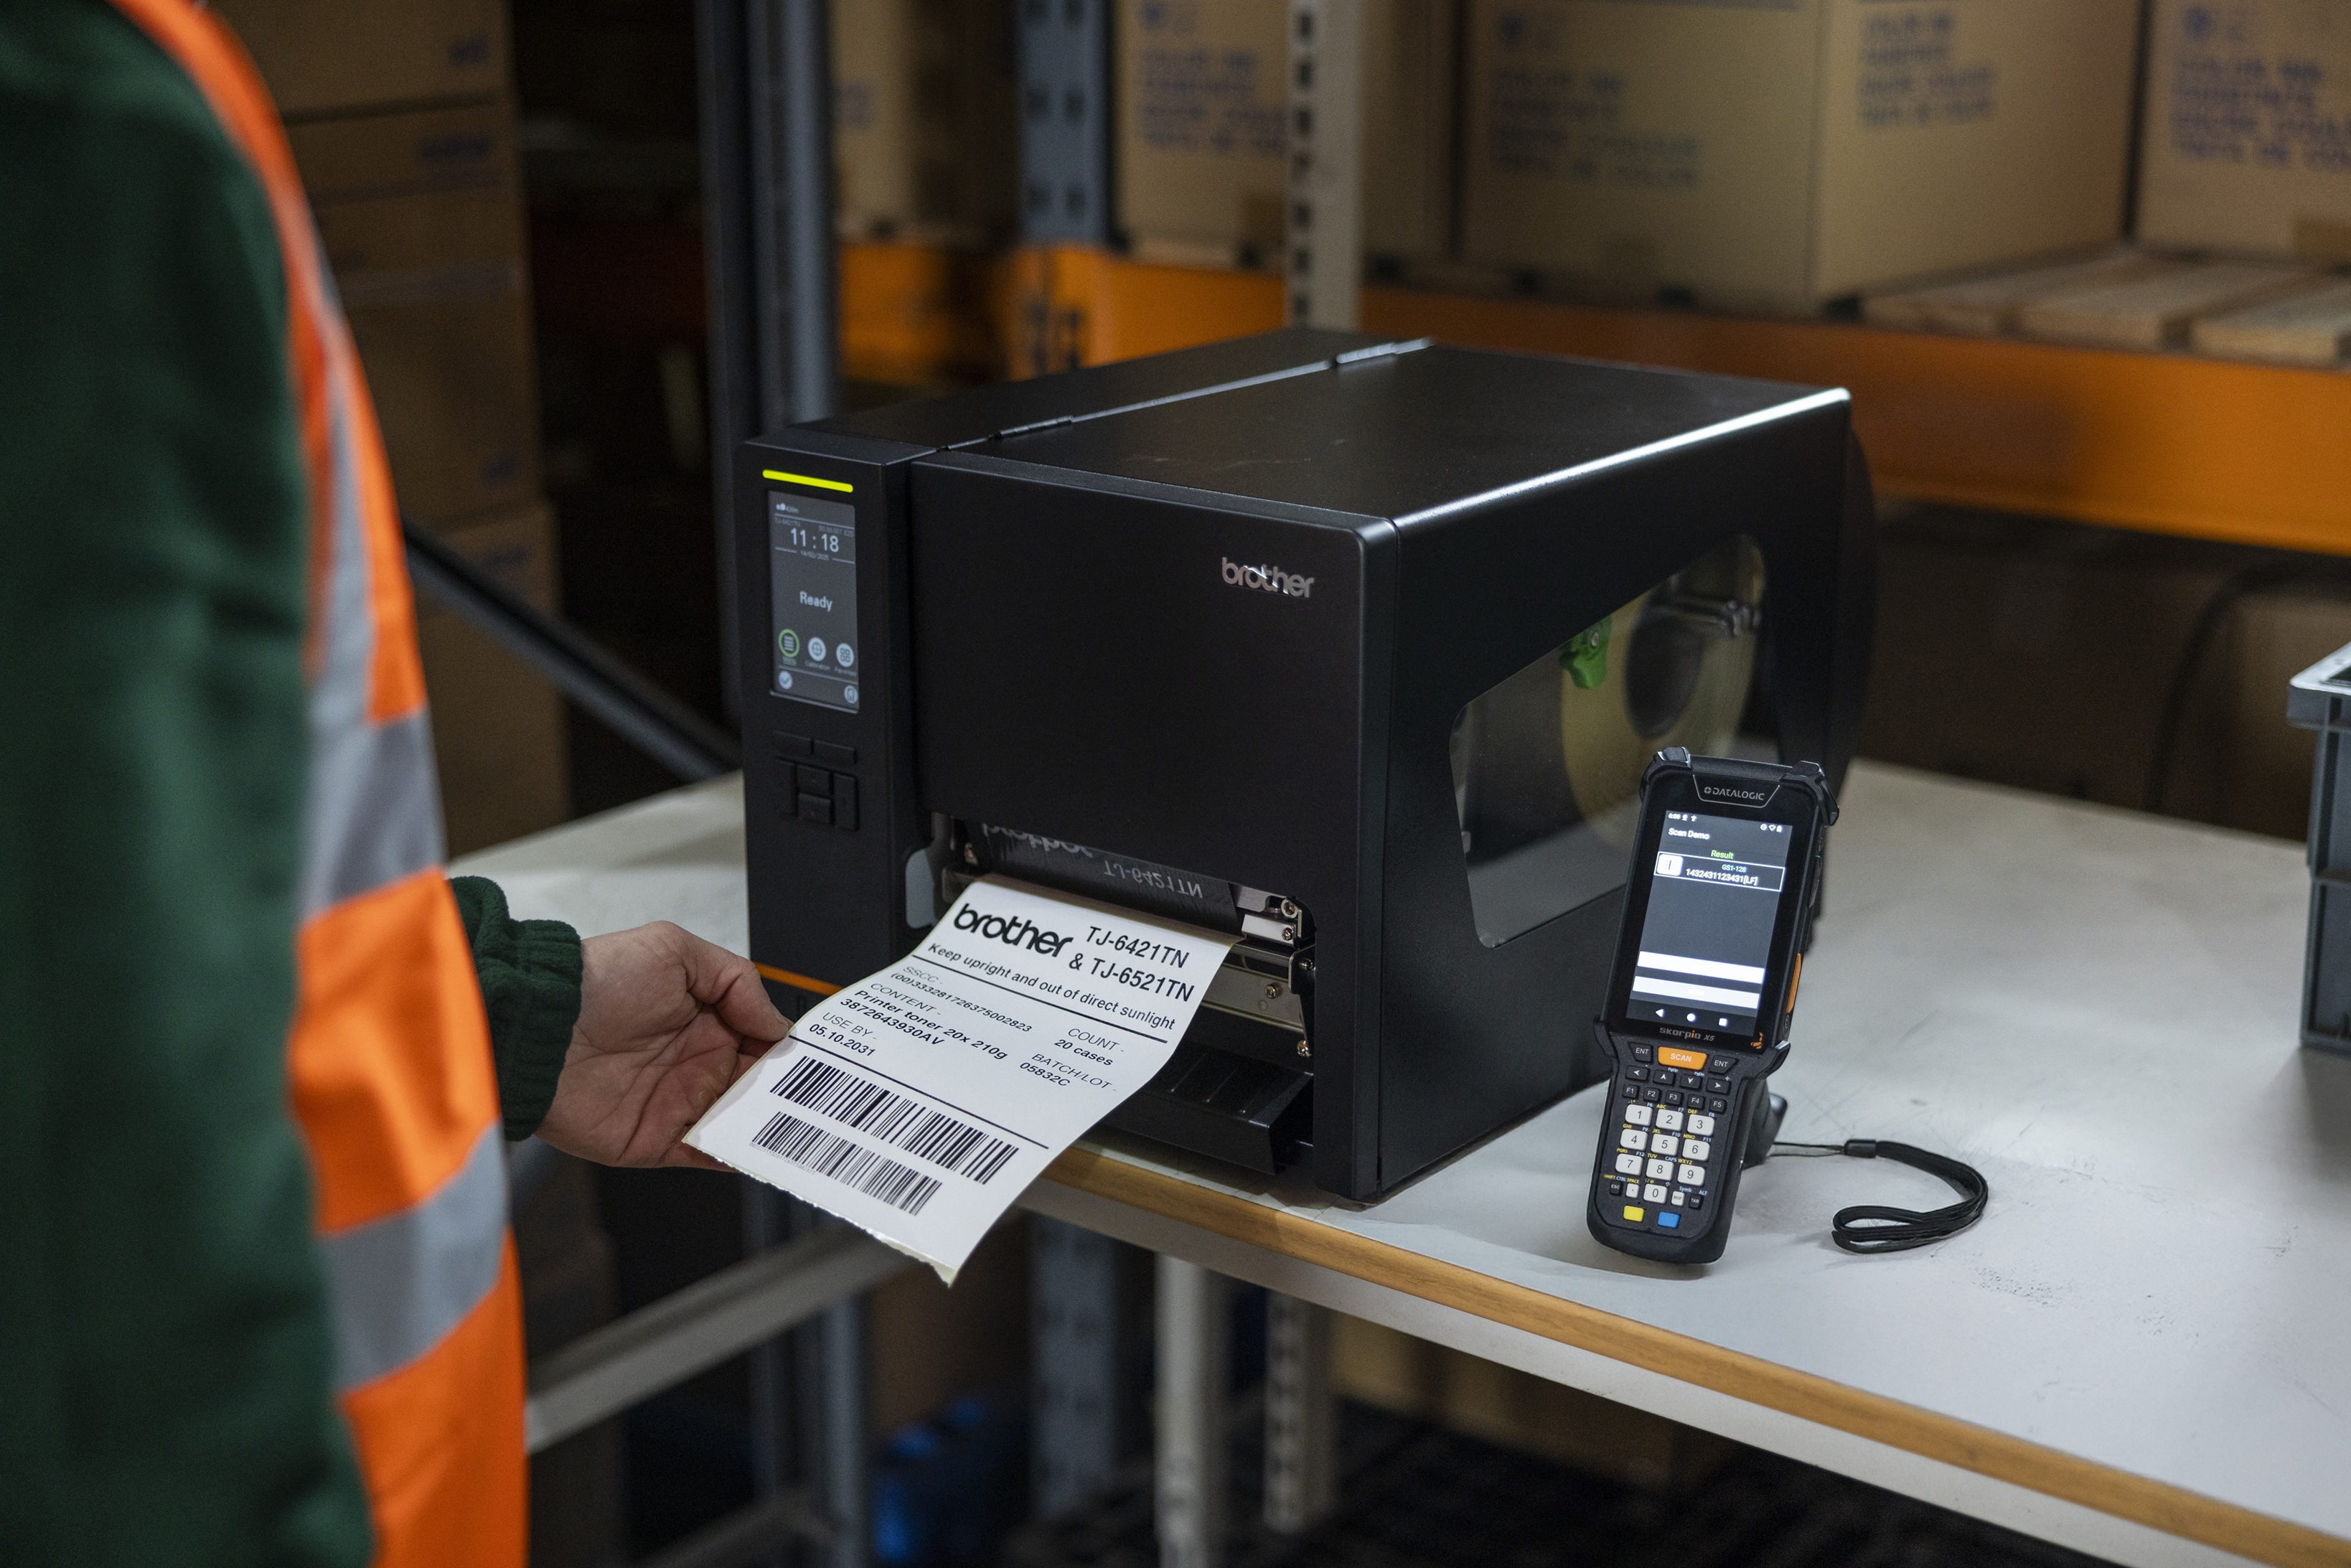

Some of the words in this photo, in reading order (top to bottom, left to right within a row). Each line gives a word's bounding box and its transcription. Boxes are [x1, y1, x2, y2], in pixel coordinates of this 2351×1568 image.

[1221, 557, 1315, 598] brother
[799, 591, 833, 611] Ready
[1712, 787, 1765, 801] DATALOGIC
[1668, 827, 1687, 837] Scan
[1688, 830, 1710, 840] Demo
[1711, 850, 1735, 860] Result
[1722, 864, 1747, 873] GS1-128
[954, 903, 1074, 957] brother
[1086, 926, 1190, 968] TJ-6421TN
[903, 966, 939, 985] SSCC
[1069, 953, 1084, 970] &
[1090, 957, 1195, 1002] TJ-6521TN
[928, 943, 962, 962] Keep
[963, 955, 1011, 979] upright
[1012, 971, 1039, 987] and
[1039, 980, 1061, 995] out
[1064, 988, 1080, 1000] of
[1080, 993, 1119, 1013] direct
[1120, 1006, 1176, 1030] sunlight
[870, 983, 937, 1013] CONTENT
[822, 1012, 853, 1030] USE
[850, 1024, 873, 1038] BY
[840, 998, 946, 1046] 3872643930AV
[854, 990, 904, 1013] Printer
[904, 1011, 944, 1031] toner
[943, 1028, 971, 1043] 20x
[971, 1040, 1008, 1060] 210g
[809, 1023, 876, 1056] 05.10.2031
[1068, 1028, 1119, 1052] COUNT
[1054, 1039, 1073, 1049] 20
[1074, 1048, 1114, 1066] cases
[1671, 1053, 1692, 1062] SCAN
[1020, 1062, 1071, 1087] 05832C
[1031, 1053, 1112, 1091] BATCH/LOT
[1637, 1110, 1642, 1119] 1
[1666, 1114, 1673, 1124] 2
[1696, 1119, 1703, 1130] 3
[1630, 1135, 1638, 1144] 4
[1661, 1140, 1669, 1149] 5
[1691, 1145, 1699, 1154] 6
[1627, 1159, 1634, 1168] 7
[1656, 1165, 1663, 1174] 8
[1686, 1170, 1694, 1179] 9
[1652, 1188, 1659, 1198] 0
